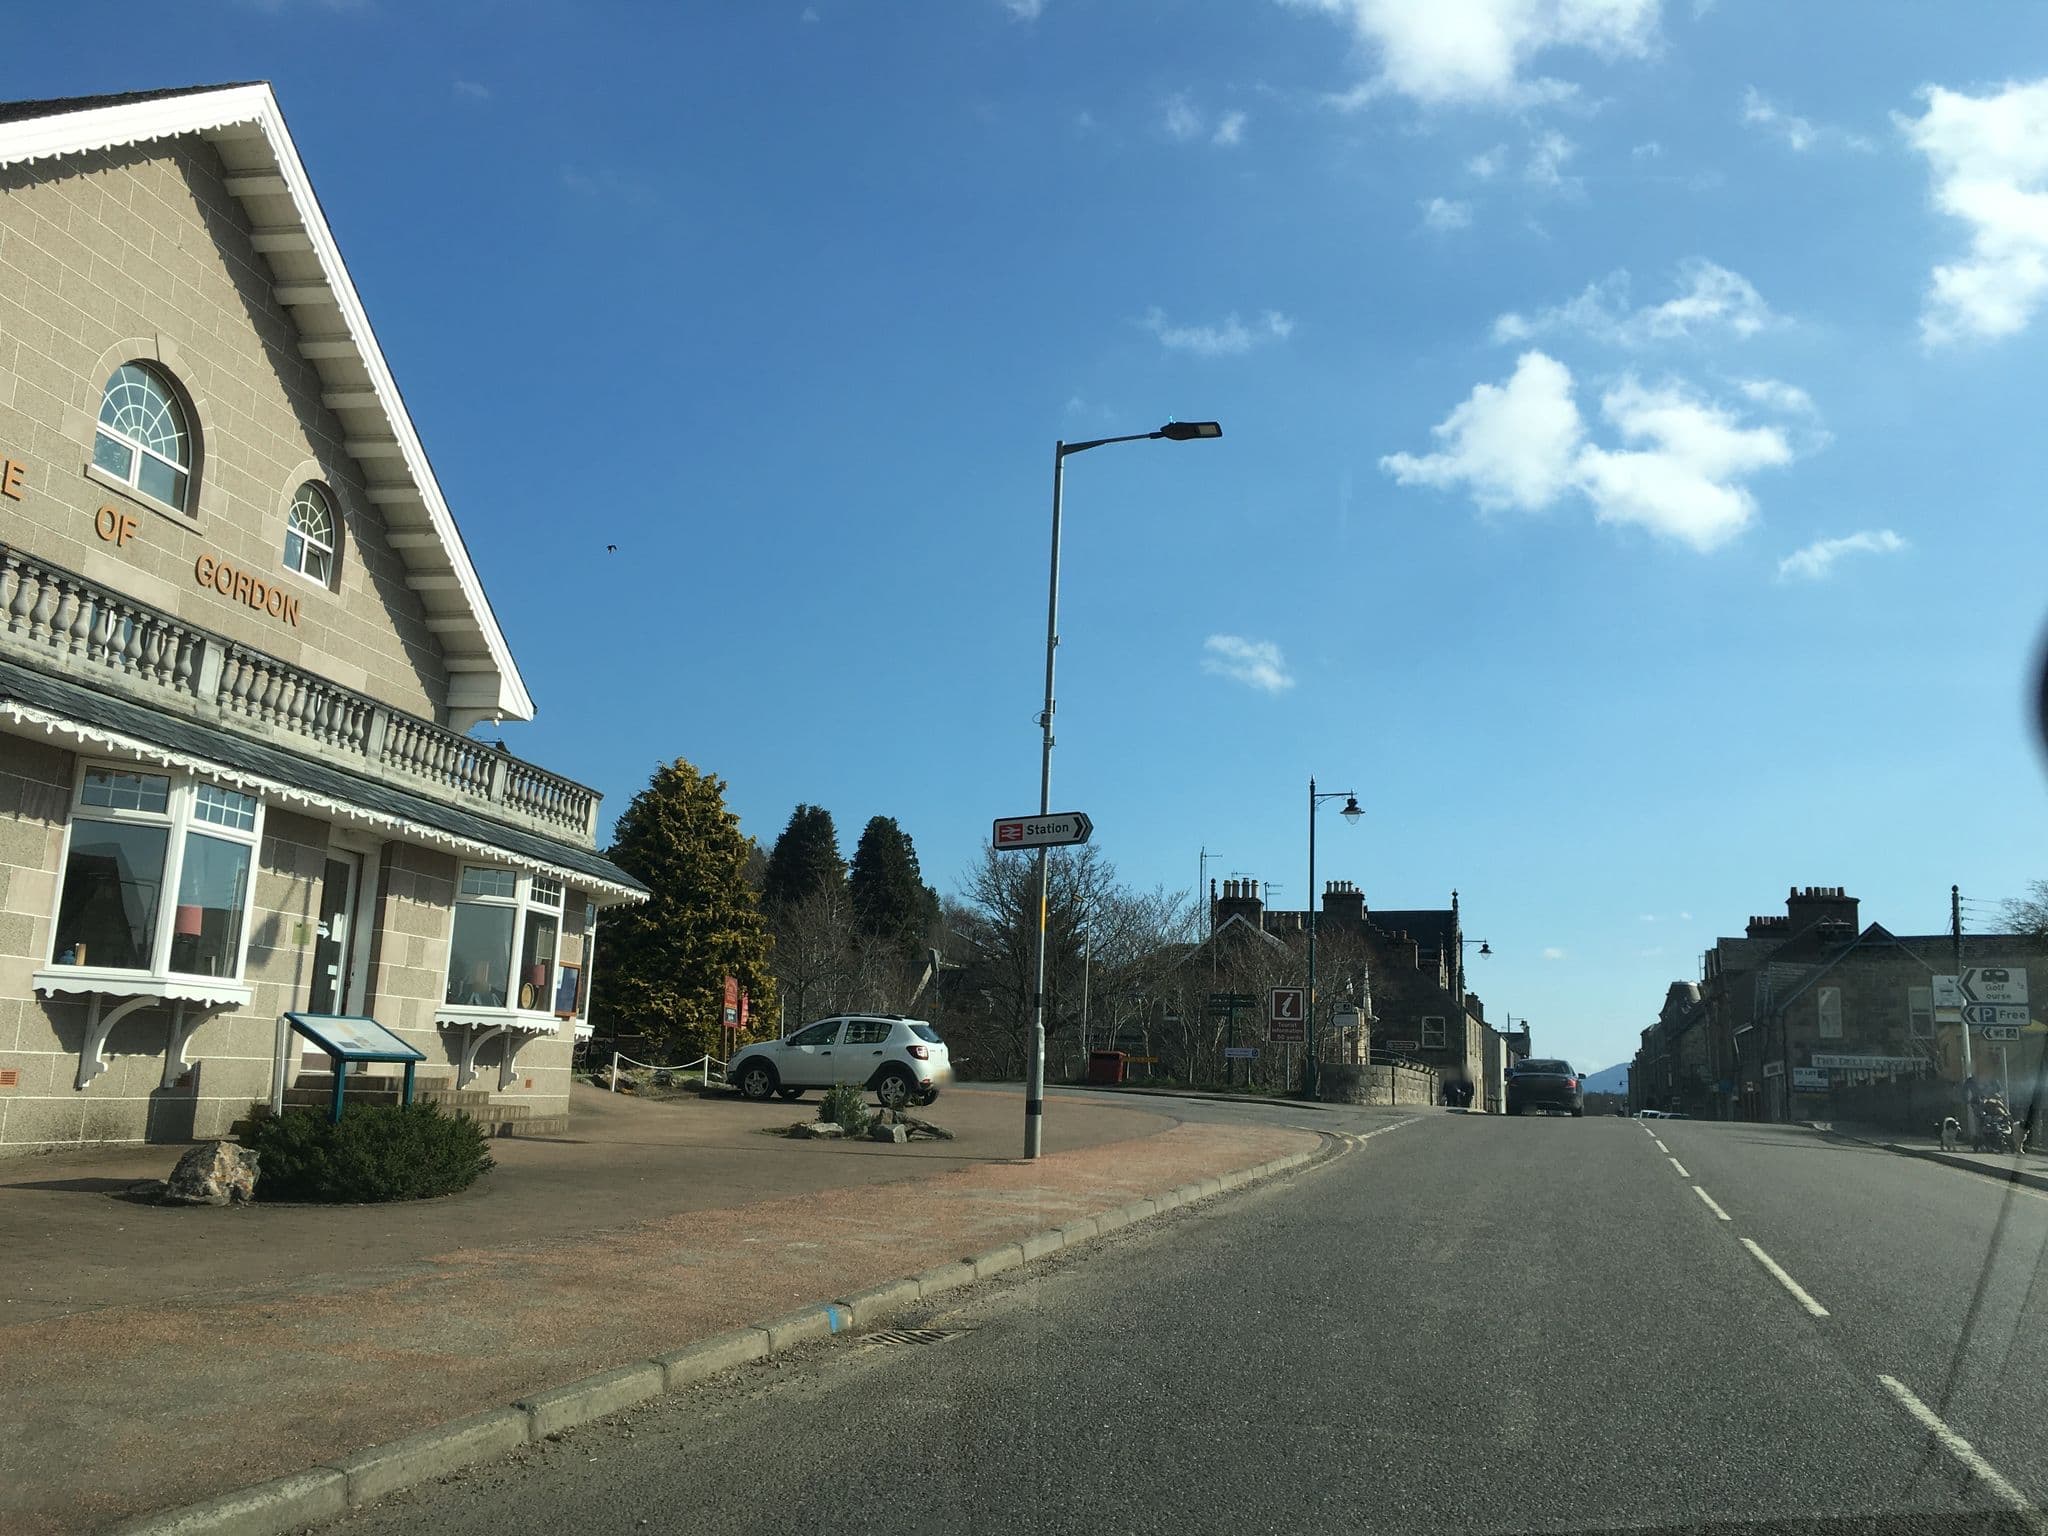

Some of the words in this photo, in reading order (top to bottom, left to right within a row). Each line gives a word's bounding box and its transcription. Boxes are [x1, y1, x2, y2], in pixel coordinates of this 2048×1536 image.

[95, 504, 137, 547] OF
[195, 553, 299, 627] GORDON
[1026, 823, 1069, 836] Station
[2000, 1010, 2026, 1020] Free
